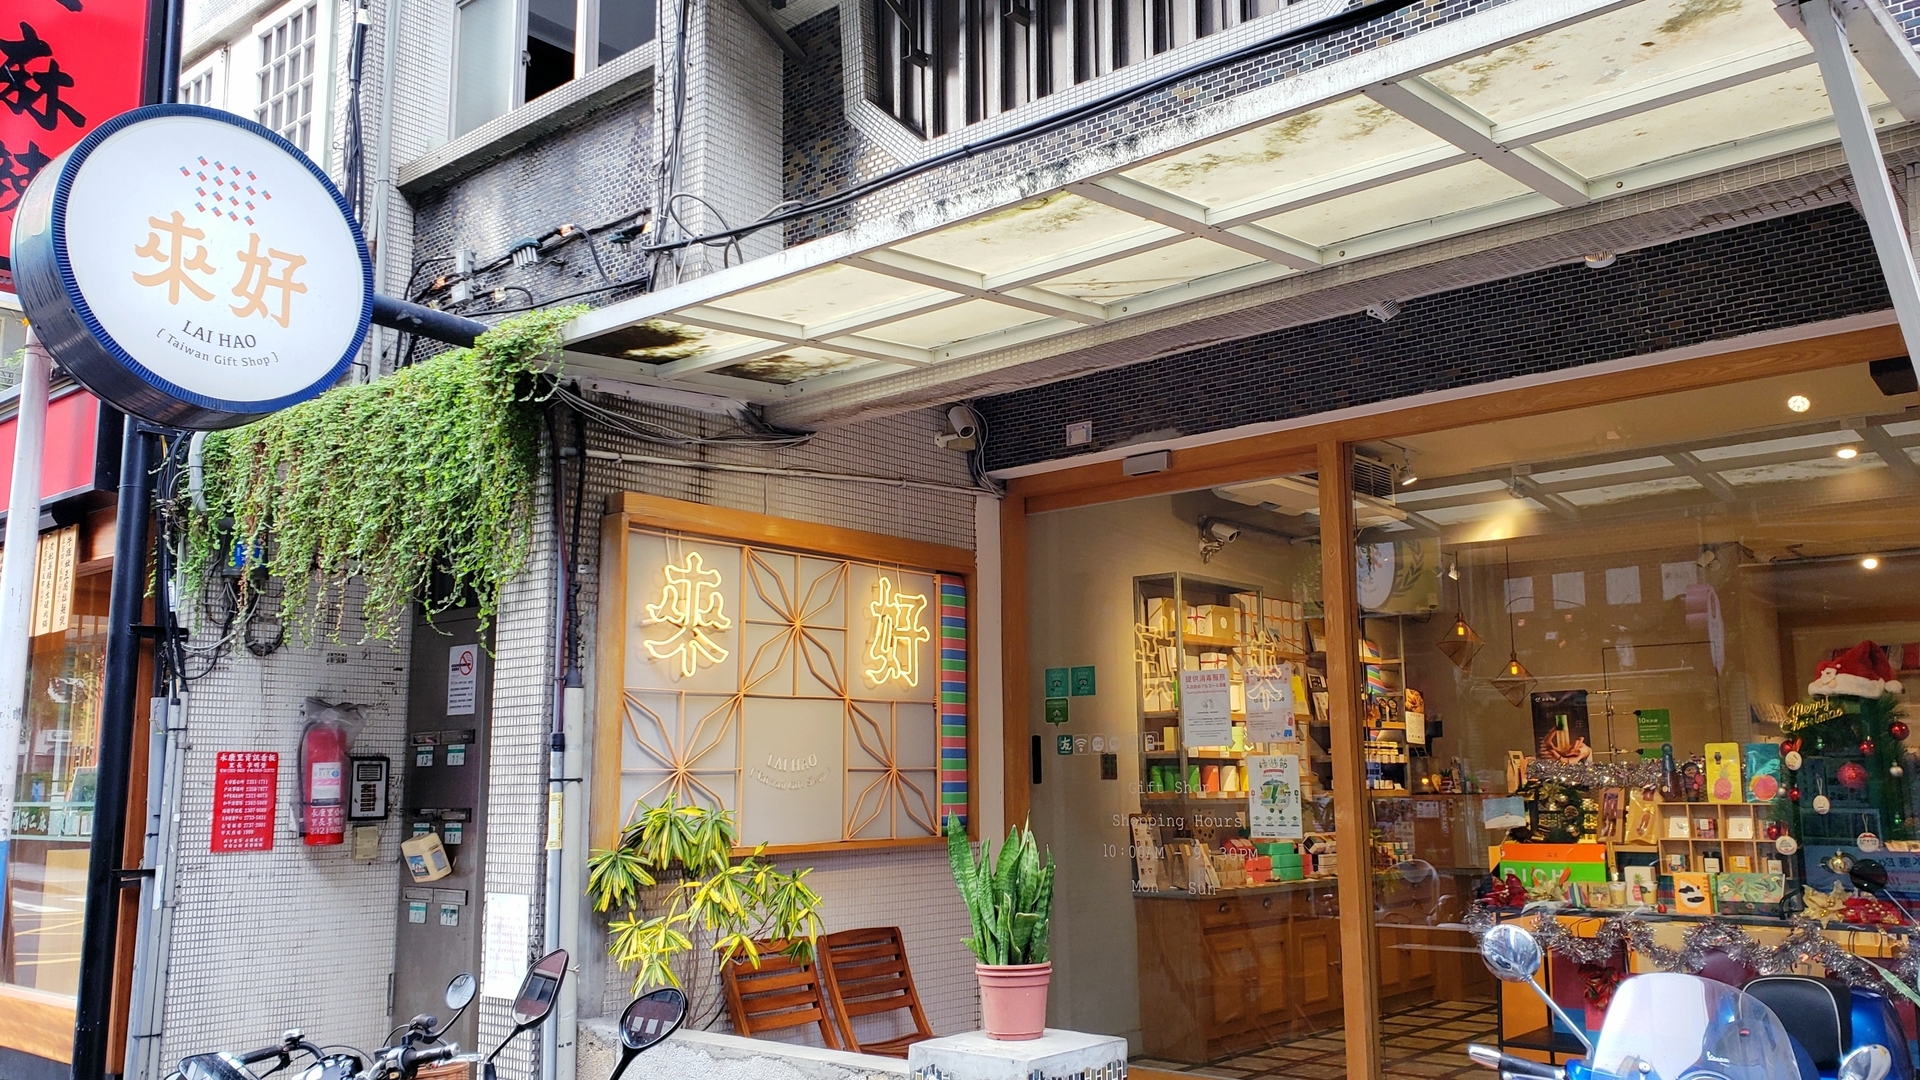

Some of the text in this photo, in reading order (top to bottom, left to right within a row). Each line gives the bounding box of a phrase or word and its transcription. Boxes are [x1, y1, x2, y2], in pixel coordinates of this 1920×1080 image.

[133, 210, 308, 329] 來好
[181, 319, 258, 350] LAI HAO
[166, 333, 271, 368] Taiwan Gift Shop
[1185, 673, 1226, 683] 提供消毒服務
[1787, 695, 1830, 718] Merry
[766, 752, 818, 773] LAI HAO
[1128, 781, 1212, 796] Gift Shop
[1112, 814, 1243, 831] Shopping Hours
[1102, 843, 1166, 859] 10:00AM
[1131, 880, 1159, 893] Mon
[1188, 881, 1217, 896] Sun
